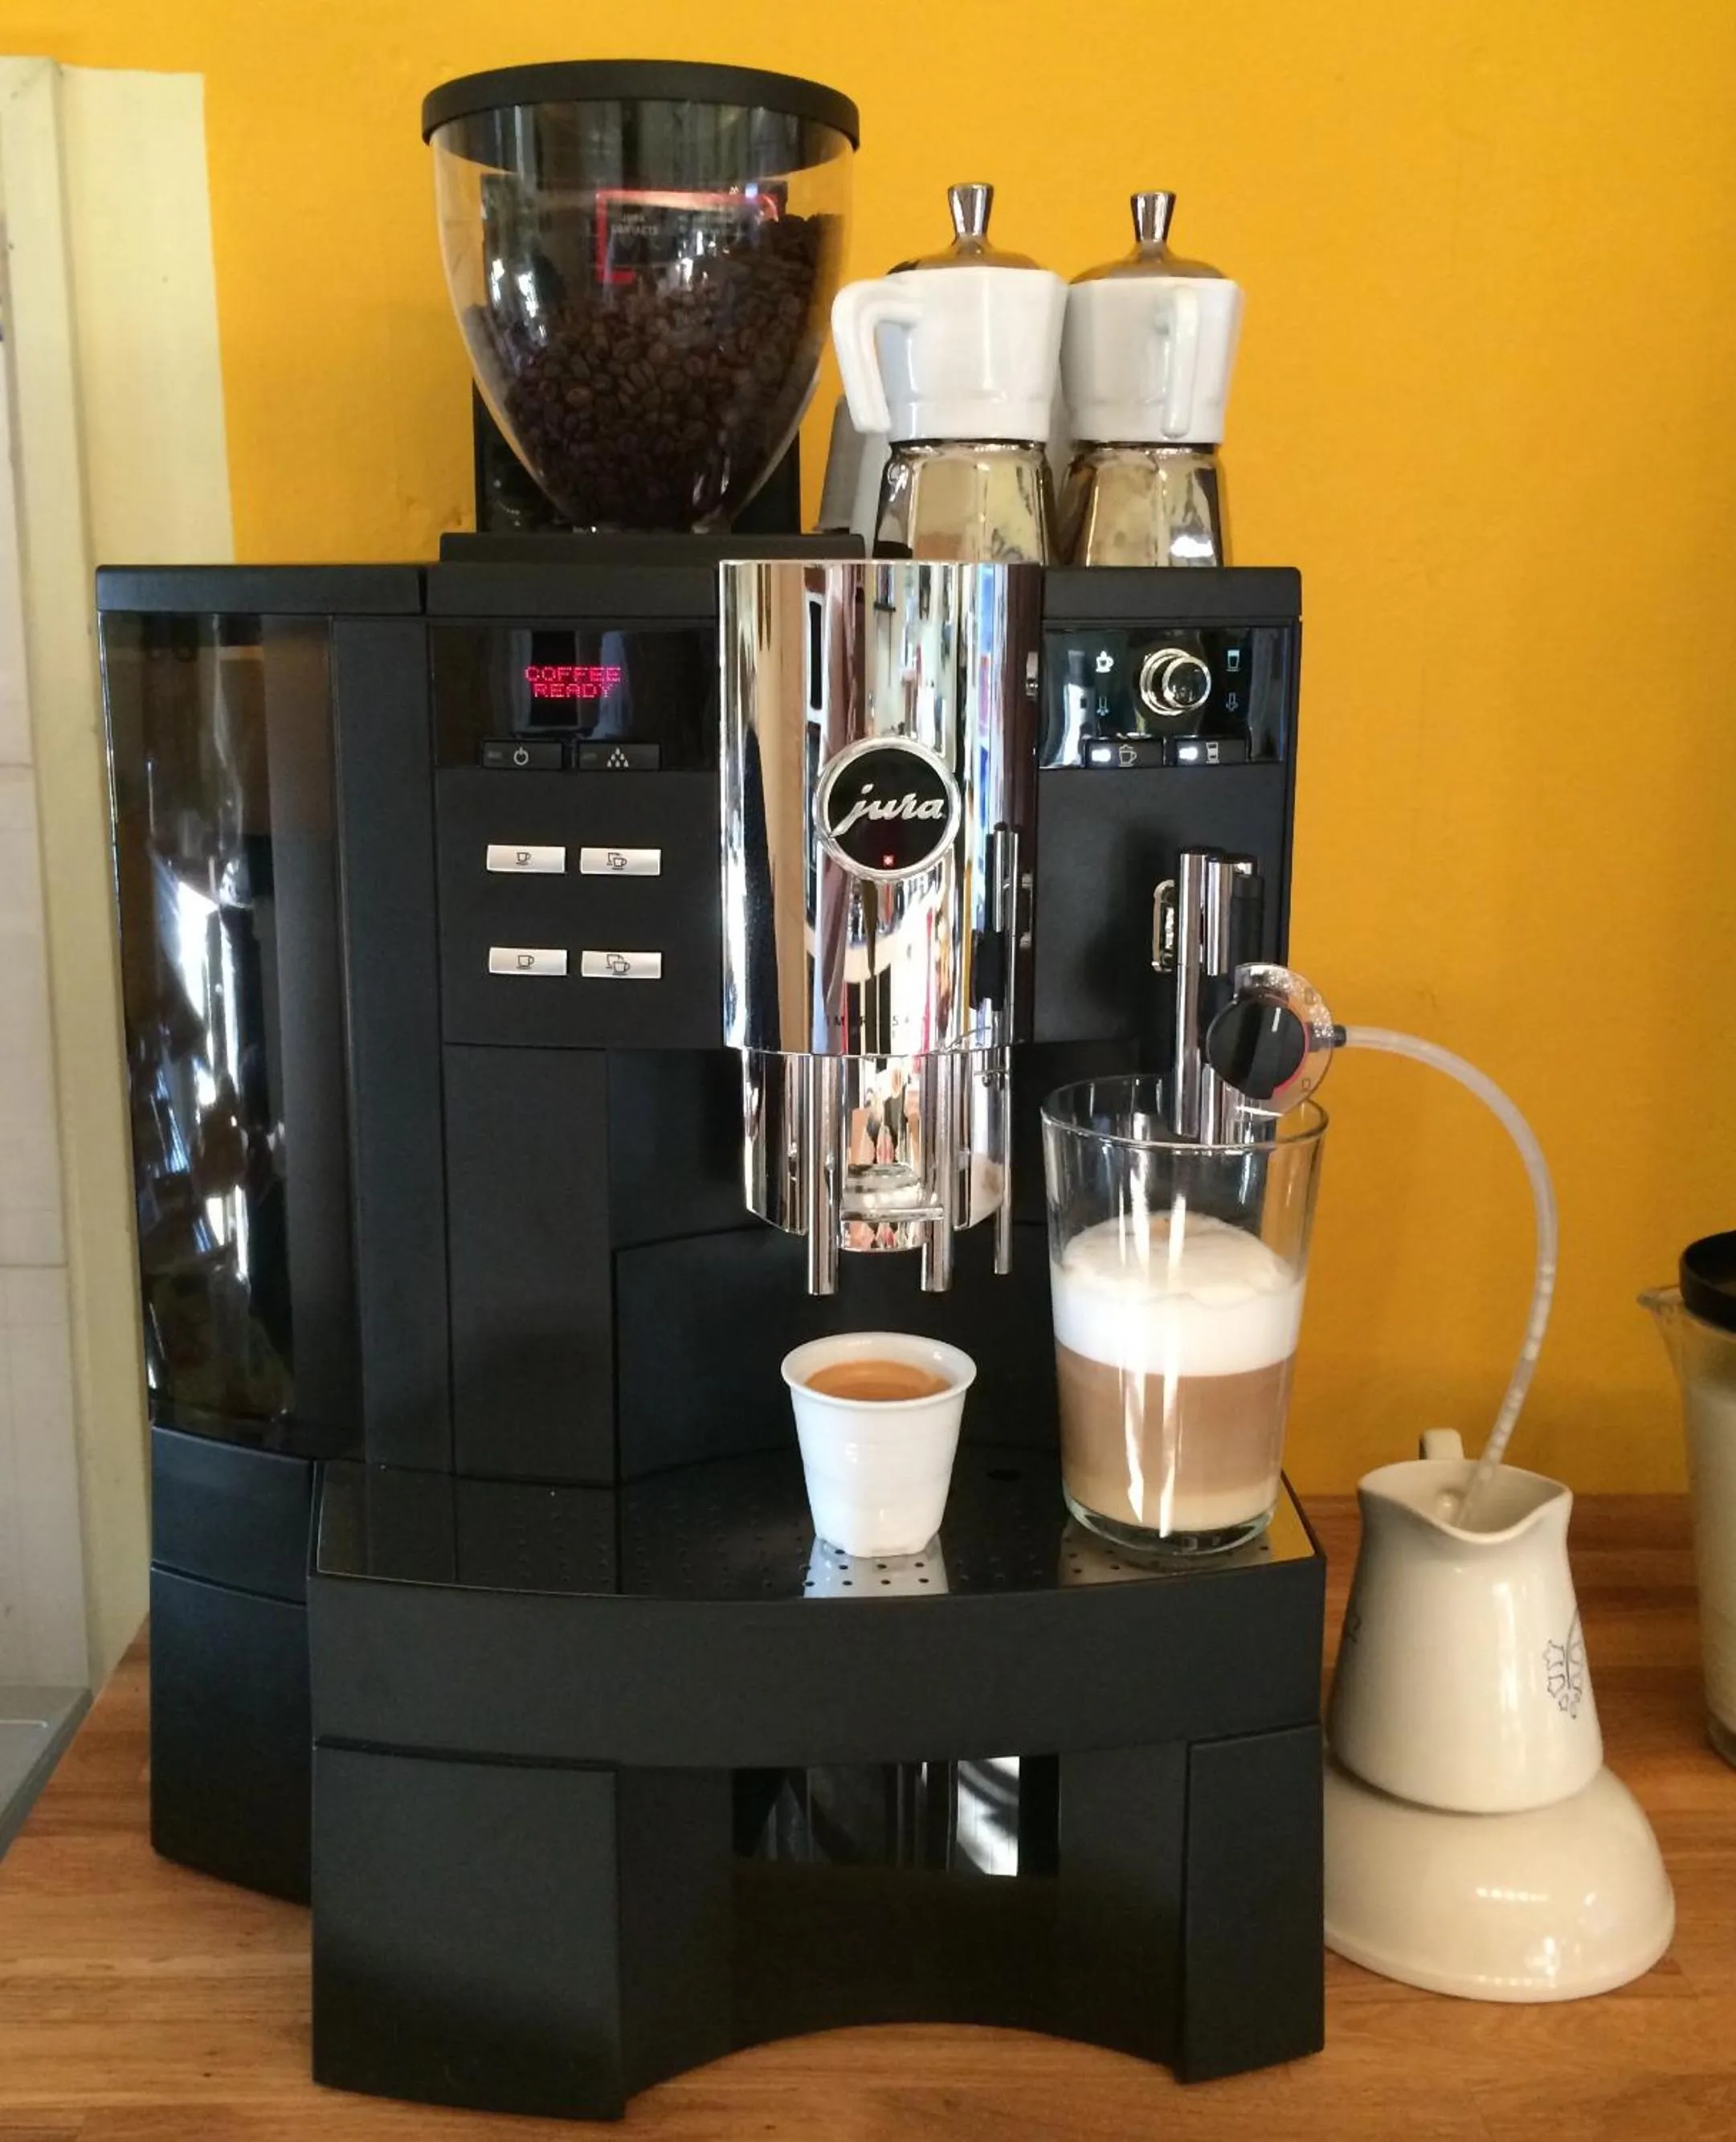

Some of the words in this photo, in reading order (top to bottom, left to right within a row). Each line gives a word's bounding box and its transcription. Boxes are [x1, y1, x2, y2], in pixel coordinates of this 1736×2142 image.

[525, 666, 621, 682] COFFEE
[533, 683, 614, 697] READY
[830, 783, 945, 837] jura
